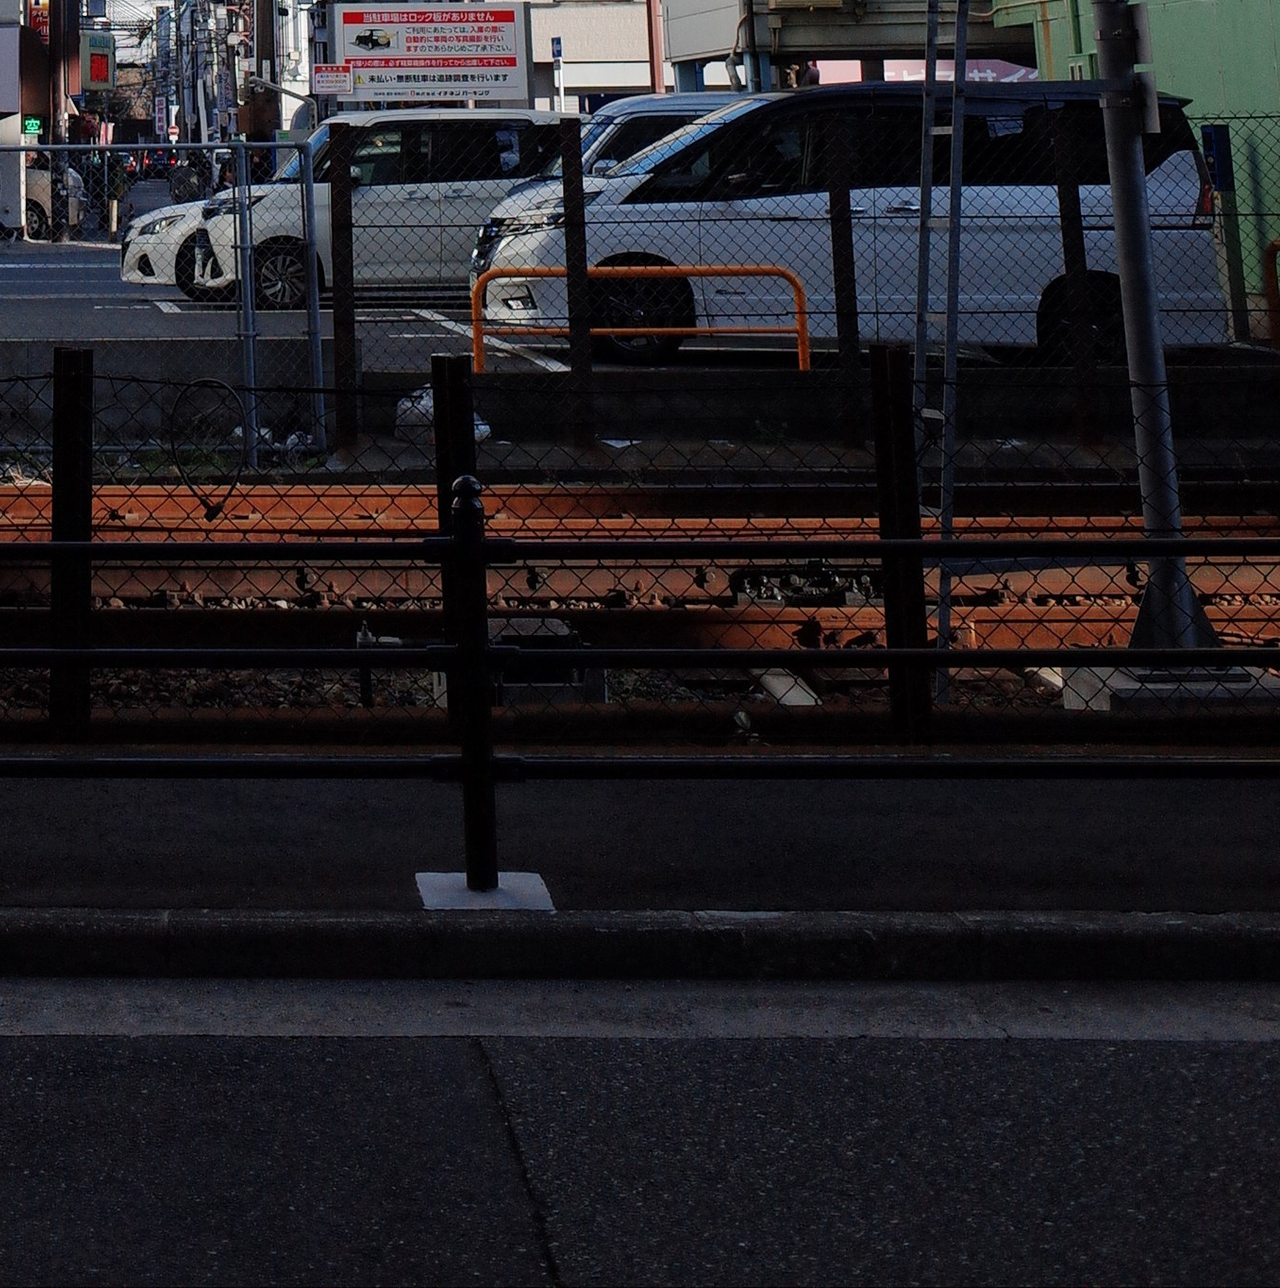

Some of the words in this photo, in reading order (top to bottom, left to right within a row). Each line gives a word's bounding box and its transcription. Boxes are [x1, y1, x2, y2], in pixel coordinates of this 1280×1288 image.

[363, 12, 495, 23] 当駐車場はロック板がありません
[368, 73, 509, 83] 未払い・無断駐車は追跡調査を行います
[25, 117, 41, 134] 空
